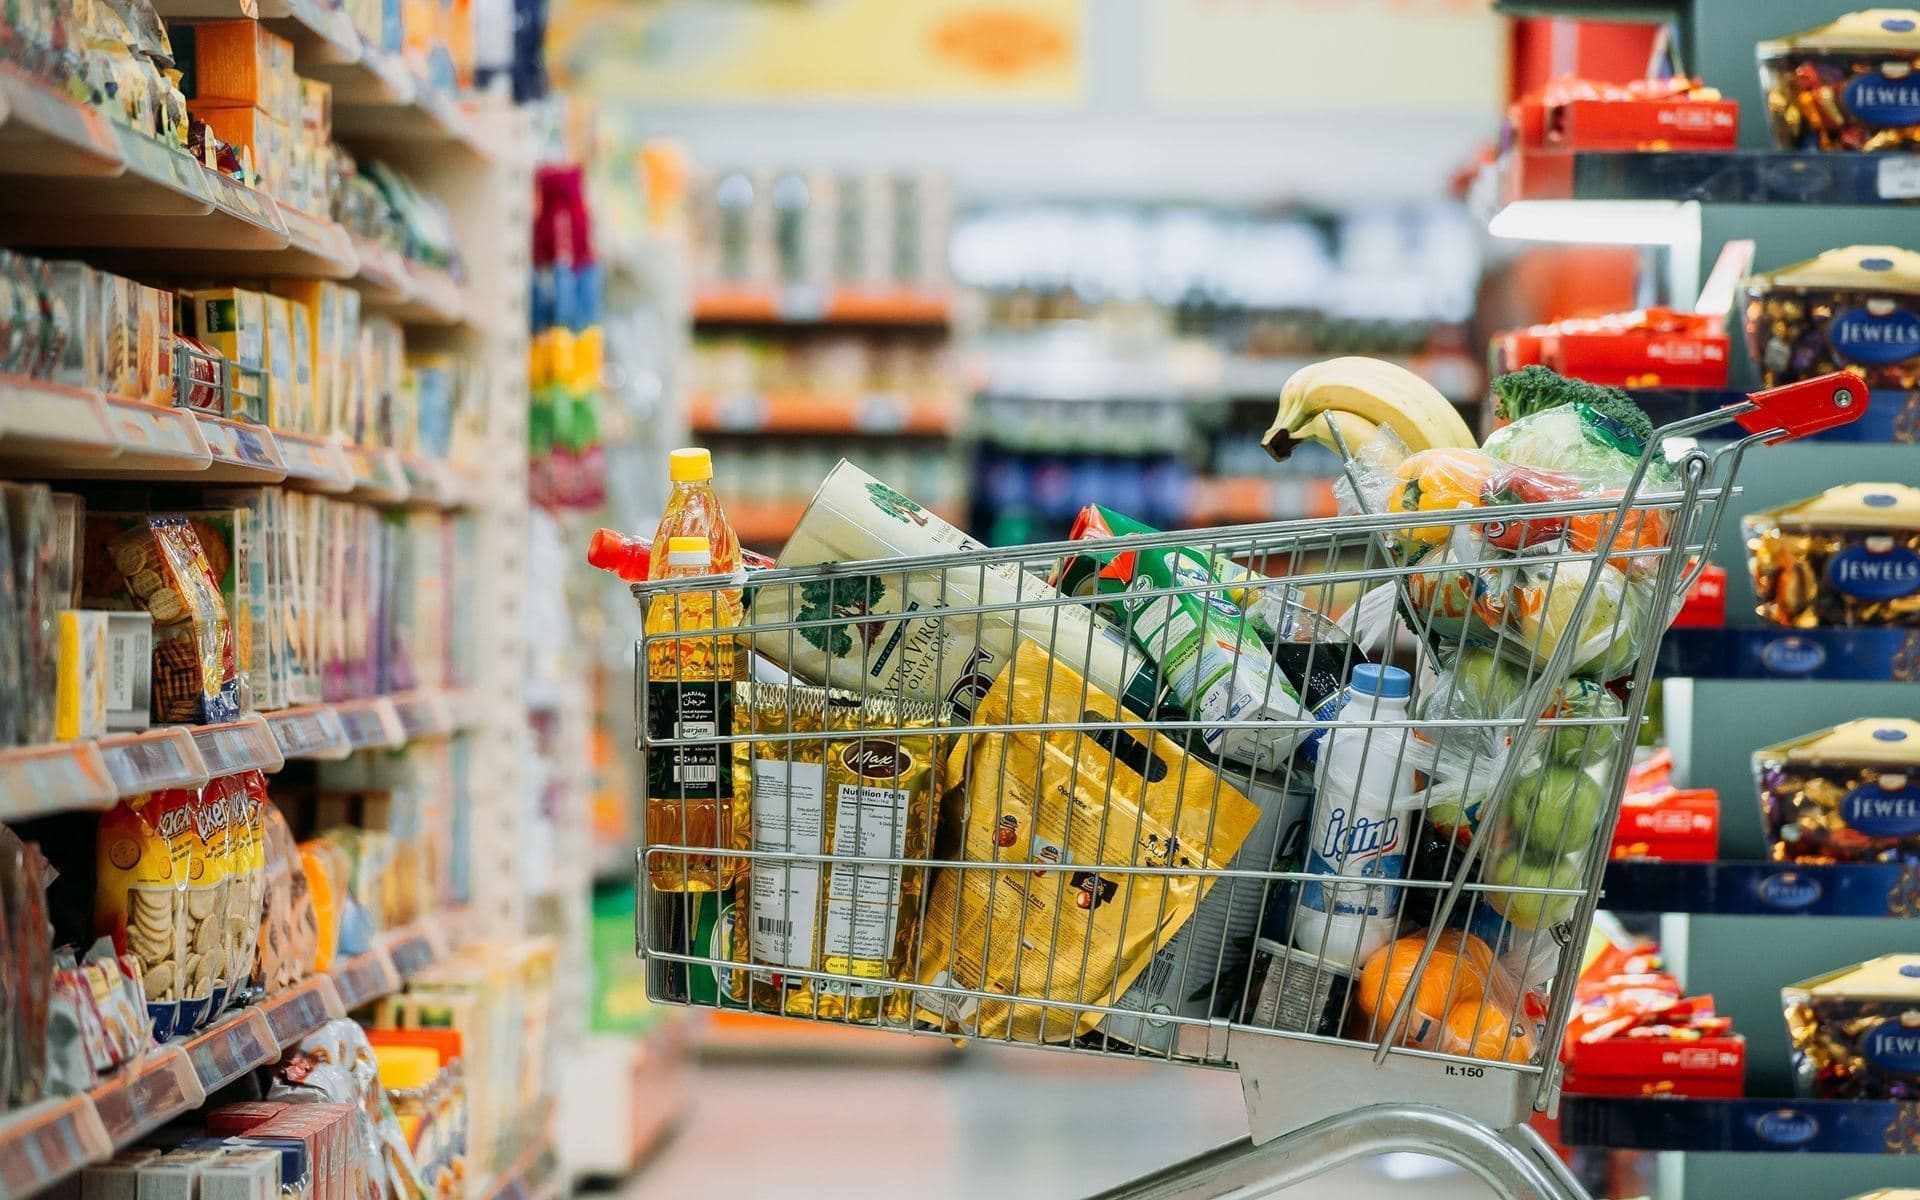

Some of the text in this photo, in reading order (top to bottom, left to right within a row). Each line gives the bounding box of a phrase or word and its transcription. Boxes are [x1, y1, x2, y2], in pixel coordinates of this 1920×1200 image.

[1841, 320, 1919, 344] JEWELS
[1841, 558, 1918, 582] JEWELS
[879, 654, 917, 702] XTRA
[904, 596, 952, 658] VIRGN
[906, 652, 936, 691] OLIVE
[682, 727, 708, 736] arjan
[847, 751, 893, 765] Max
[842, 787, 906, 801] Nutition Fats
[1853, 797, 1920, 819] JEWEL
